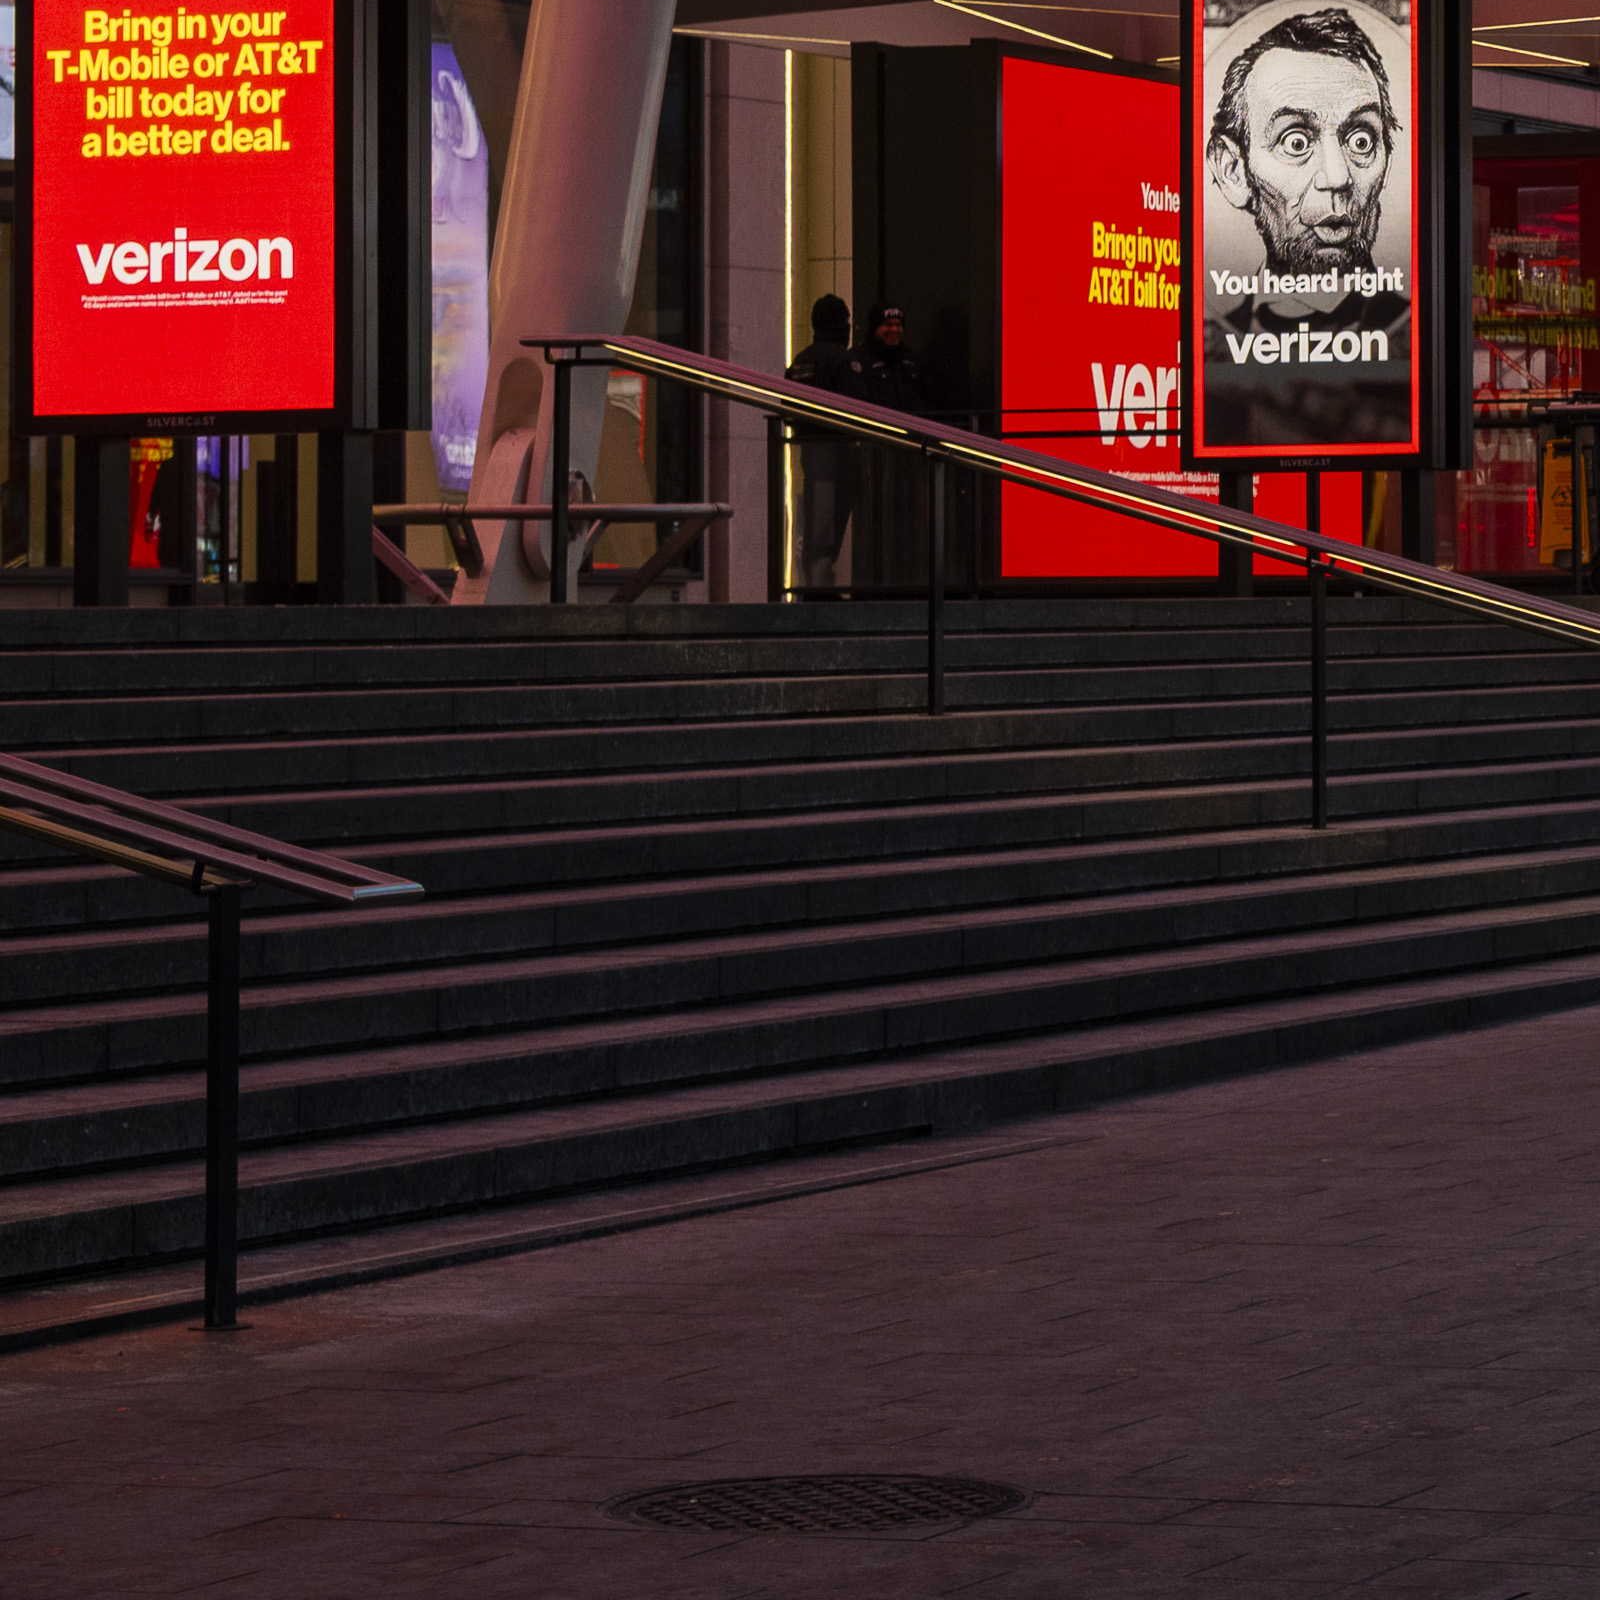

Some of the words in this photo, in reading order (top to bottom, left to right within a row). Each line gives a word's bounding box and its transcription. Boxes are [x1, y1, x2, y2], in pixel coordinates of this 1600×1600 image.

[84, 8, 173, 47] Bring
[177, 7, 207, 40] in
[211, 11, 287, 46] your
[46, 47, 190, 83] T-Mobile
[193, 51, 230, 78] or
[233, 40, 323, 77] AT&T
[86, 86, 133, 120] bill
[139, 84, 234, 122] today
[237, 82, 286, 114] for
[81, 131, 102, 158] a
[106, 124, 207, 157] better
[210, 118, 291, 154] deal.
[1141, 181, 1164, 211] You
[76, 227, 294, 285] verizon
[1092, 221, 1136, 269] Bring
[1137, 226, 1152, 264] in
[1154, 237, 1181, 272] you
[1088, 267, 1133, 306] AT&T
[1134, 271, 1157, 309] bill
[1209, 269, 1259, 297] You
[1262, 266, 1340, 296] heard
[1343, 266, 1404, 301] right
[1225, 322, 1389, 366] verizon
